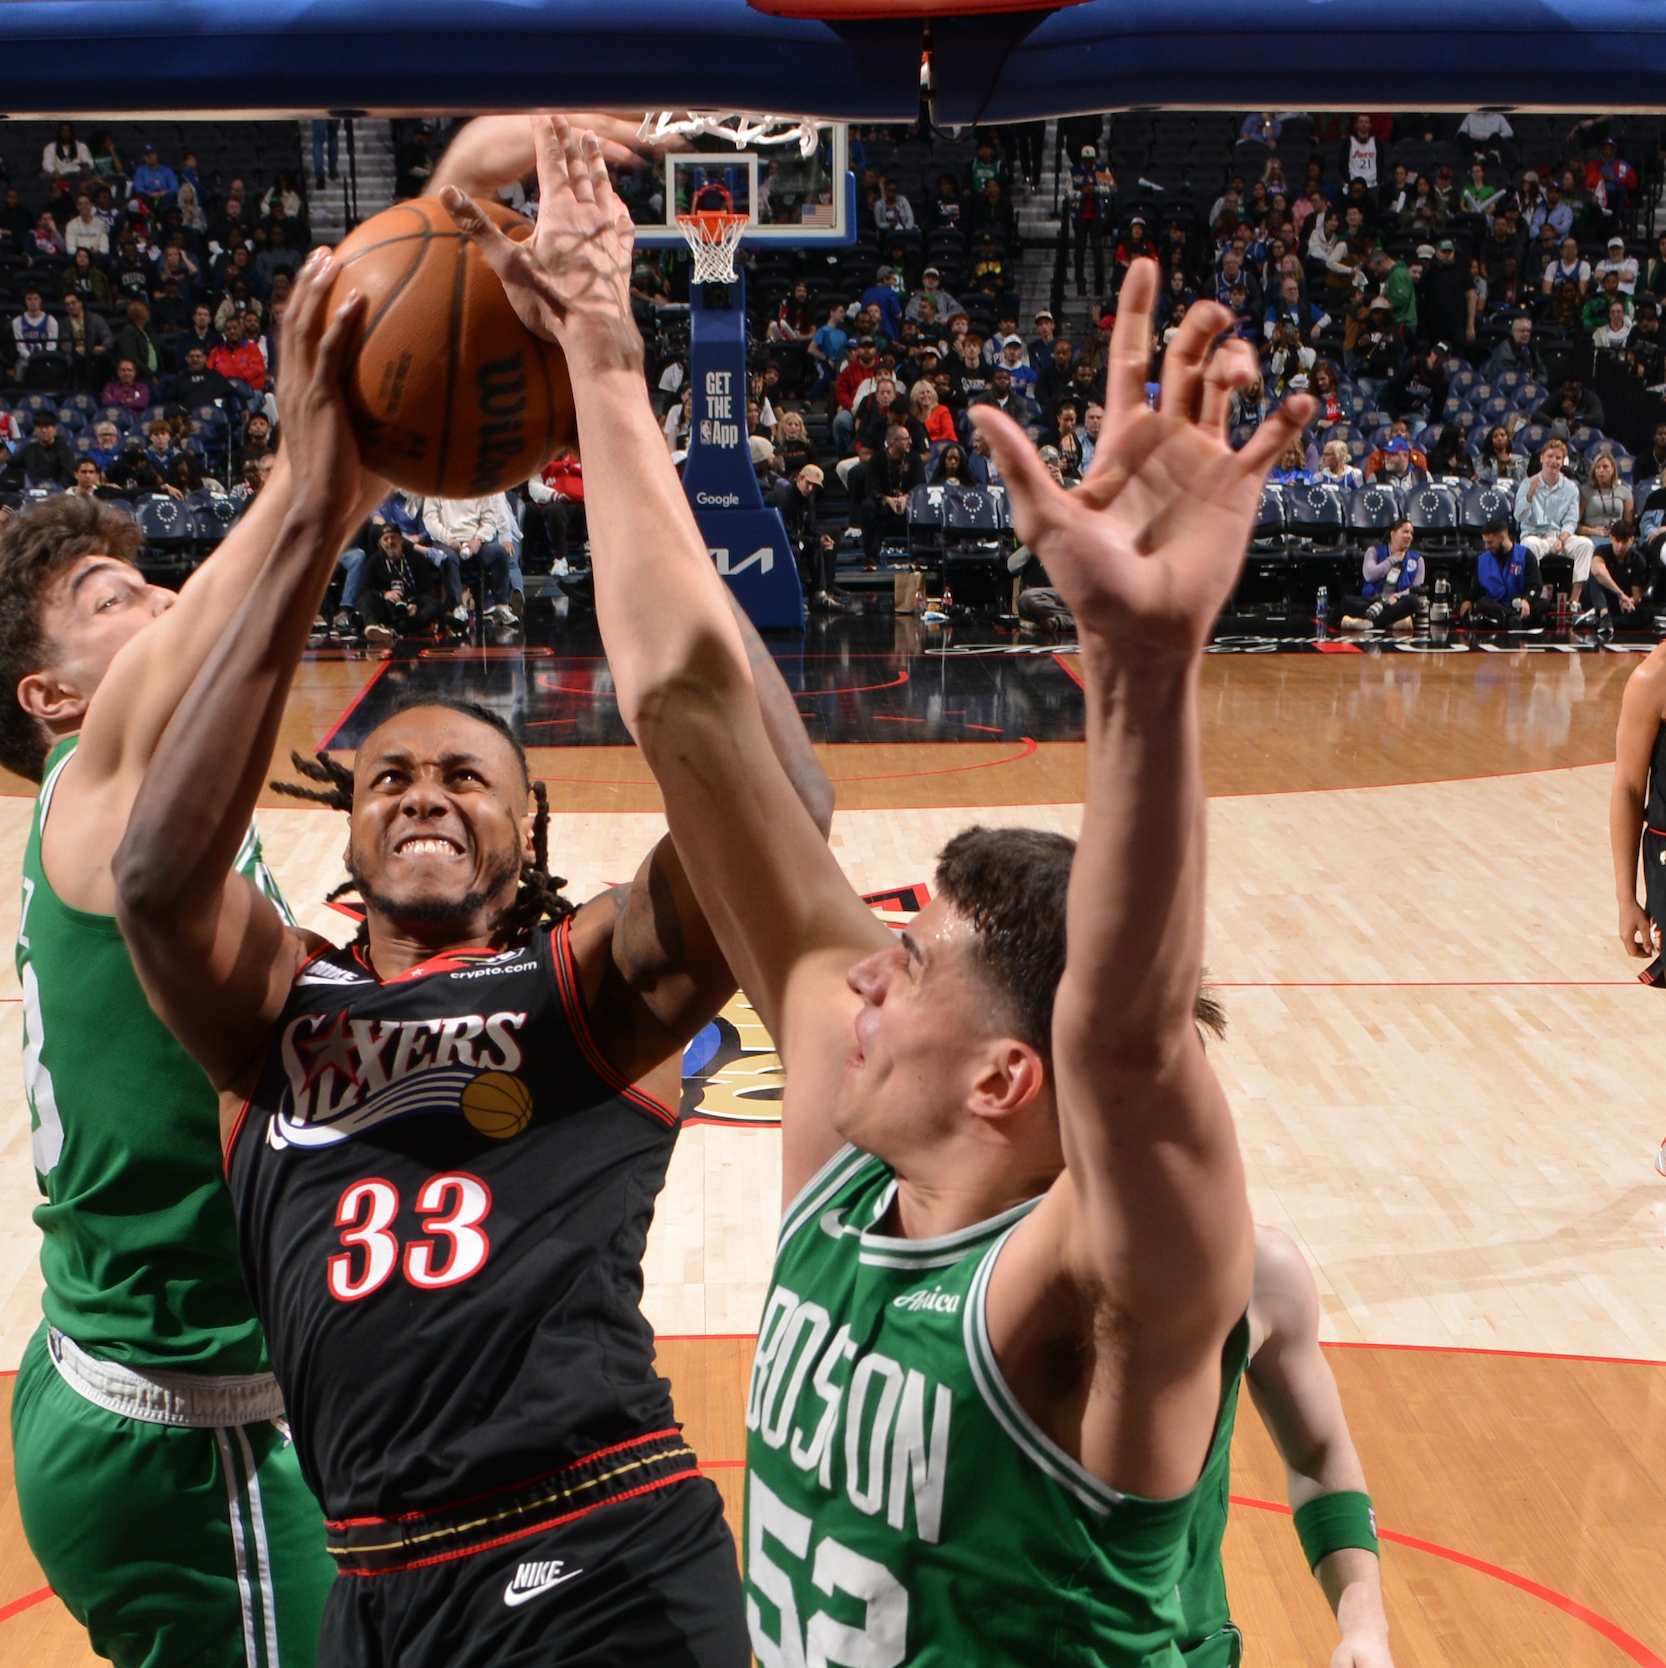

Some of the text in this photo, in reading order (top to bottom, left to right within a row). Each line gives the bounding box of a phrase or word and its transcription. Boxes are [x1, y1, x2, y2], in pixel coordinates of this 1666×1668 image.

[1360, 159, 1371, 169] 21
[706, 371, 732, 395] GET
[706, 396, 732, 419] THE
[469, 349, 526, 496] Wilso
[712, 420, 738, 449] App
[696, 491, 739, 508] Google
[1394, 643, 1659, 654] ULTR
[306, 958, 360, 982] NIKE
[449, 958, 538, 981] crypto.com
[281, 1010, 528, 1125] SIXERS
[327, 1171, 493, 1302] 33
[514, 1560, 565, 1589] NIKE
